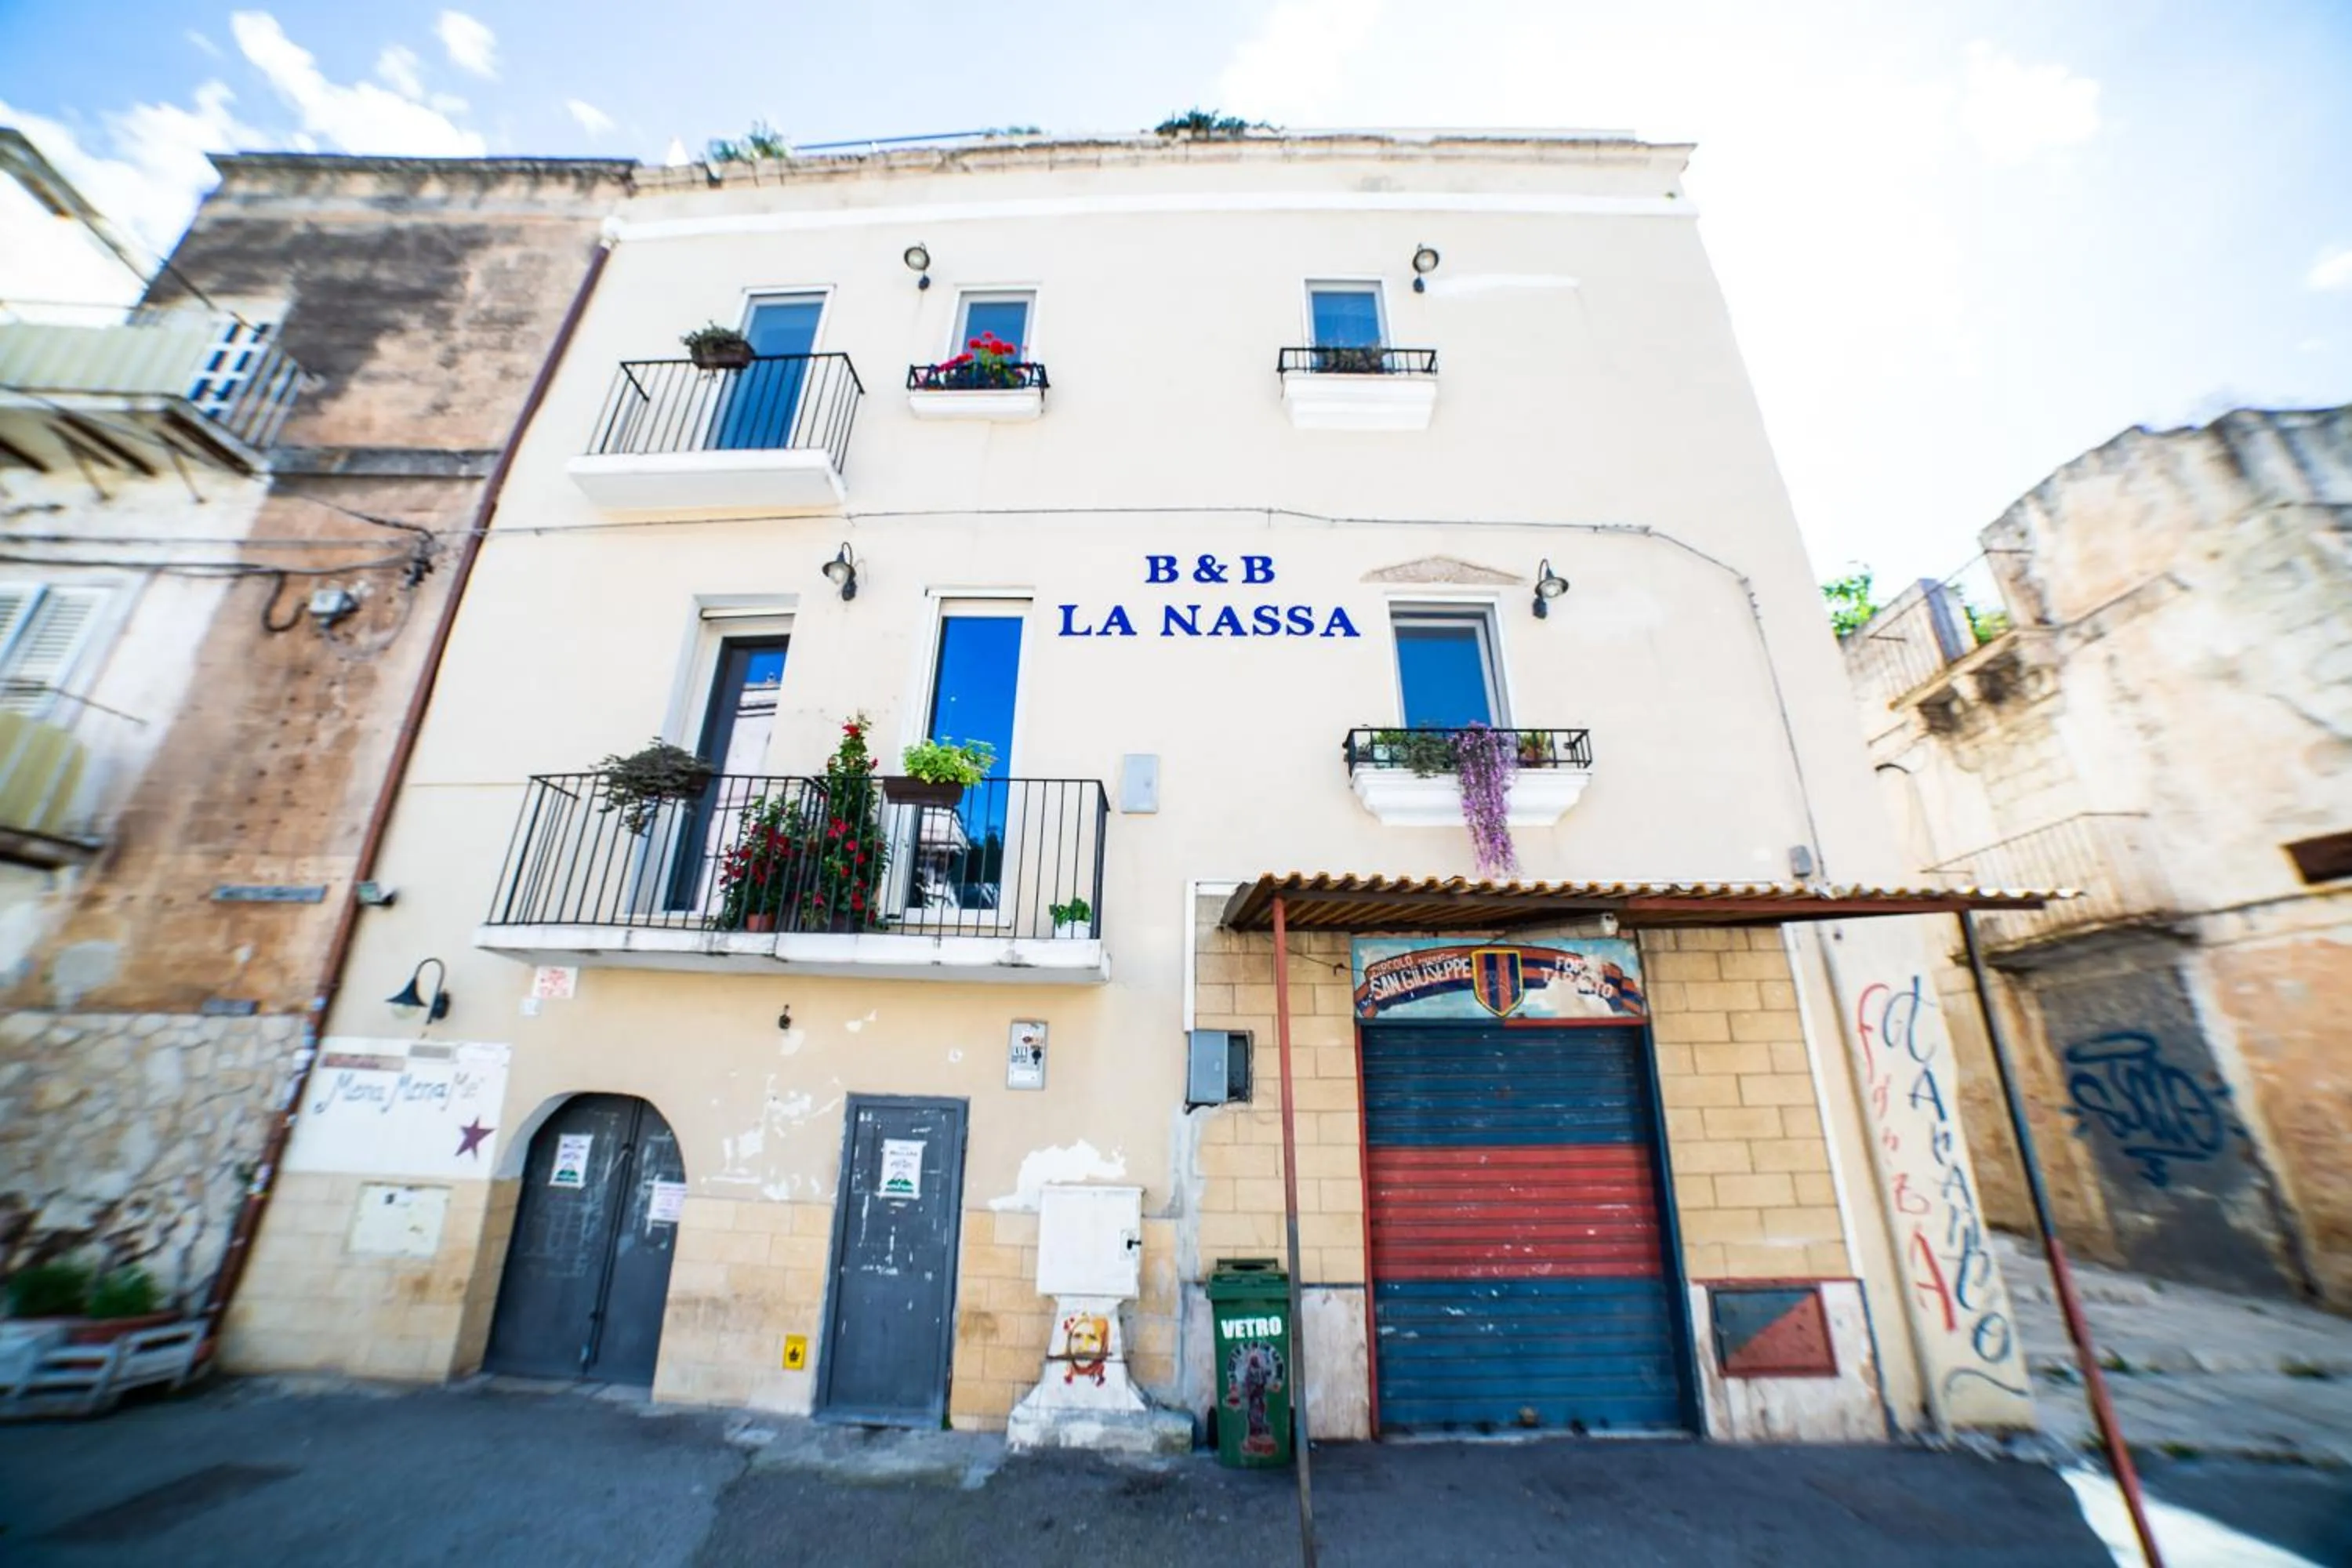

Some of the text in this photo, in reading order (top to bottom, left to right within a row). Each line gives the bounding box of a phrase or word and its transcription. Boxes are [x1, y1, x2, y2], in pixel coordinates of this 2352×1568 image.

[1058, 604, 1361, 637] LA NASSA
[1370, 972, 1403, 1001] SAN
[1220, 1316, 1283, 1340] VETRO
